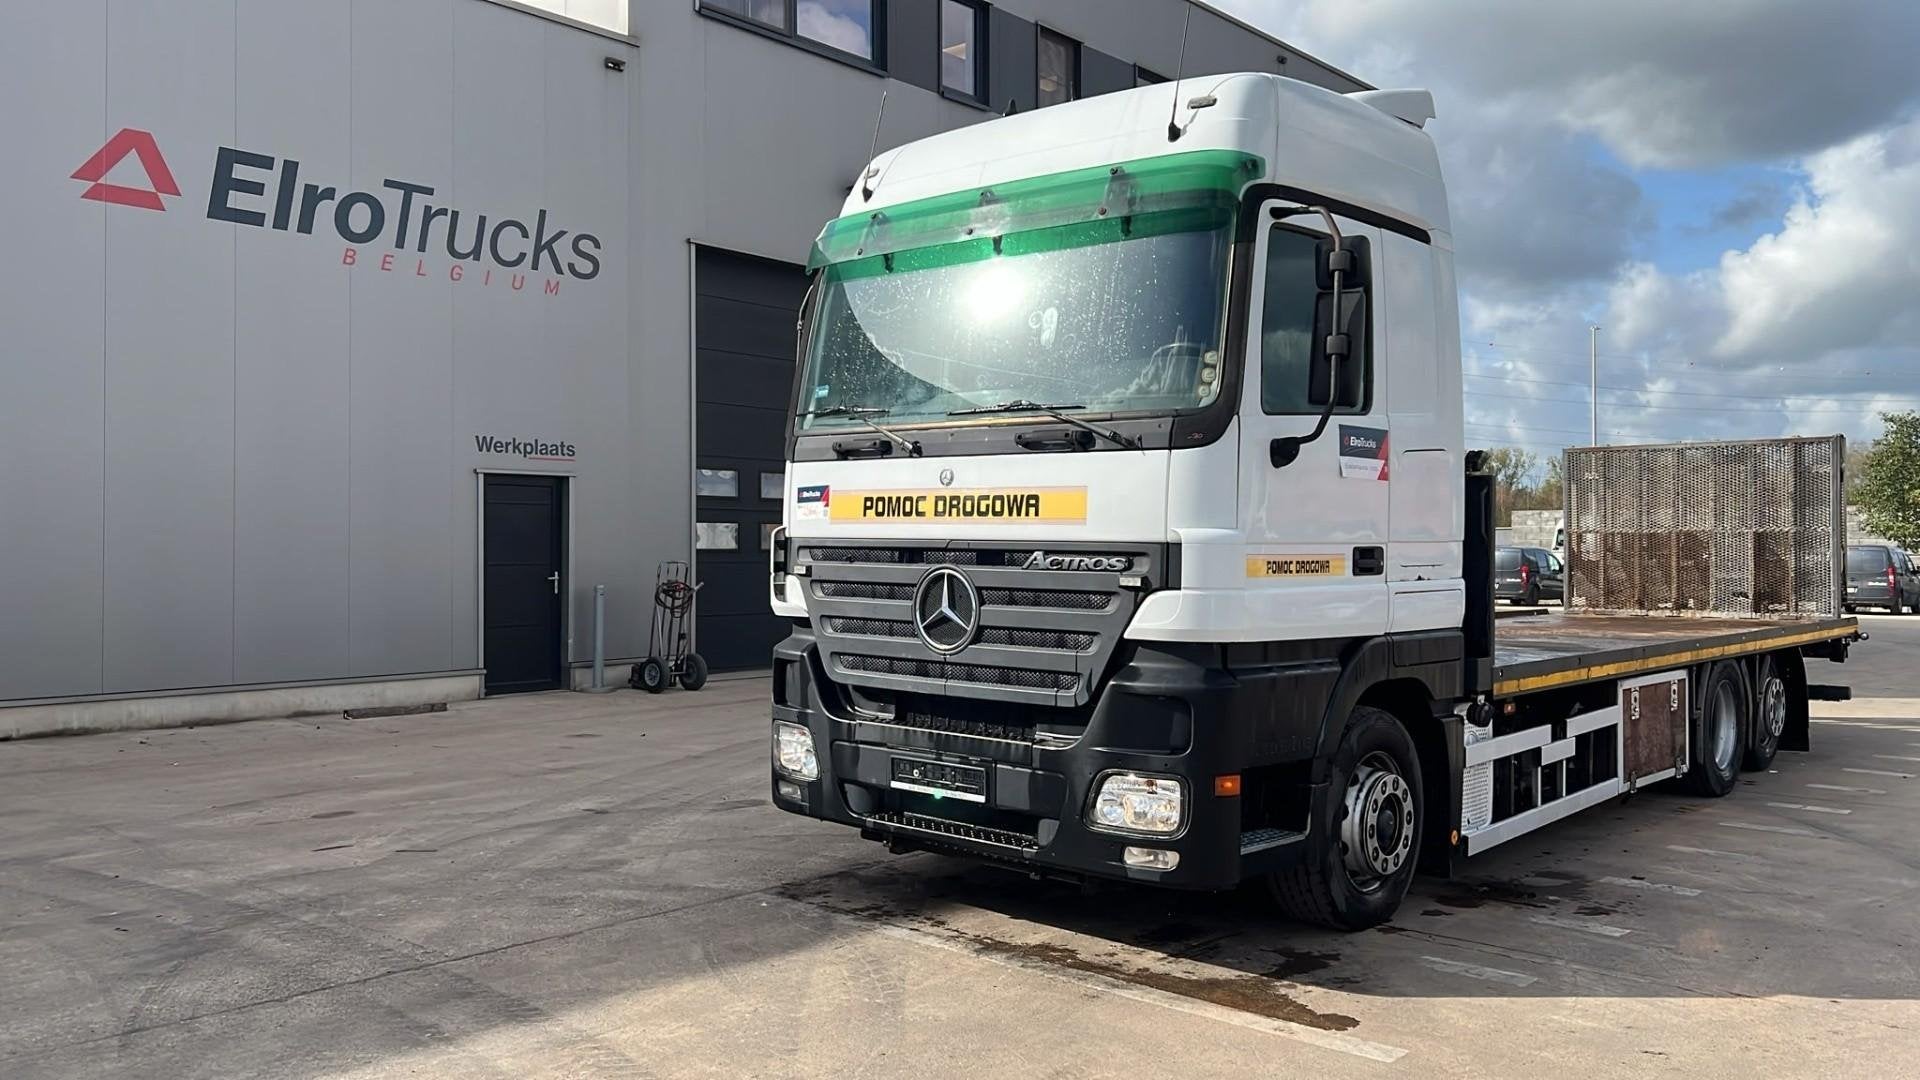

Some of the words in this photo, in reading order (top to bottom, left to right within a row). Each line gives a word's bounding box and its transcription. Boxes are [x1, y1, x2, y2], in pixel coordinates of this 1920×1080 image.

[206, 146, 602, 280] ElroTrucks
[342, 247, 561, 296] BELGIUM
[475, 435, 576, 459] Werkplaats
[863, 496, 927, 518] POMOC
[934, 494, 1040, 517] DROGOWA
[1266, 560, 1293, 574] POMOC
[1295, 560, 1330, 574] DROGOWA
